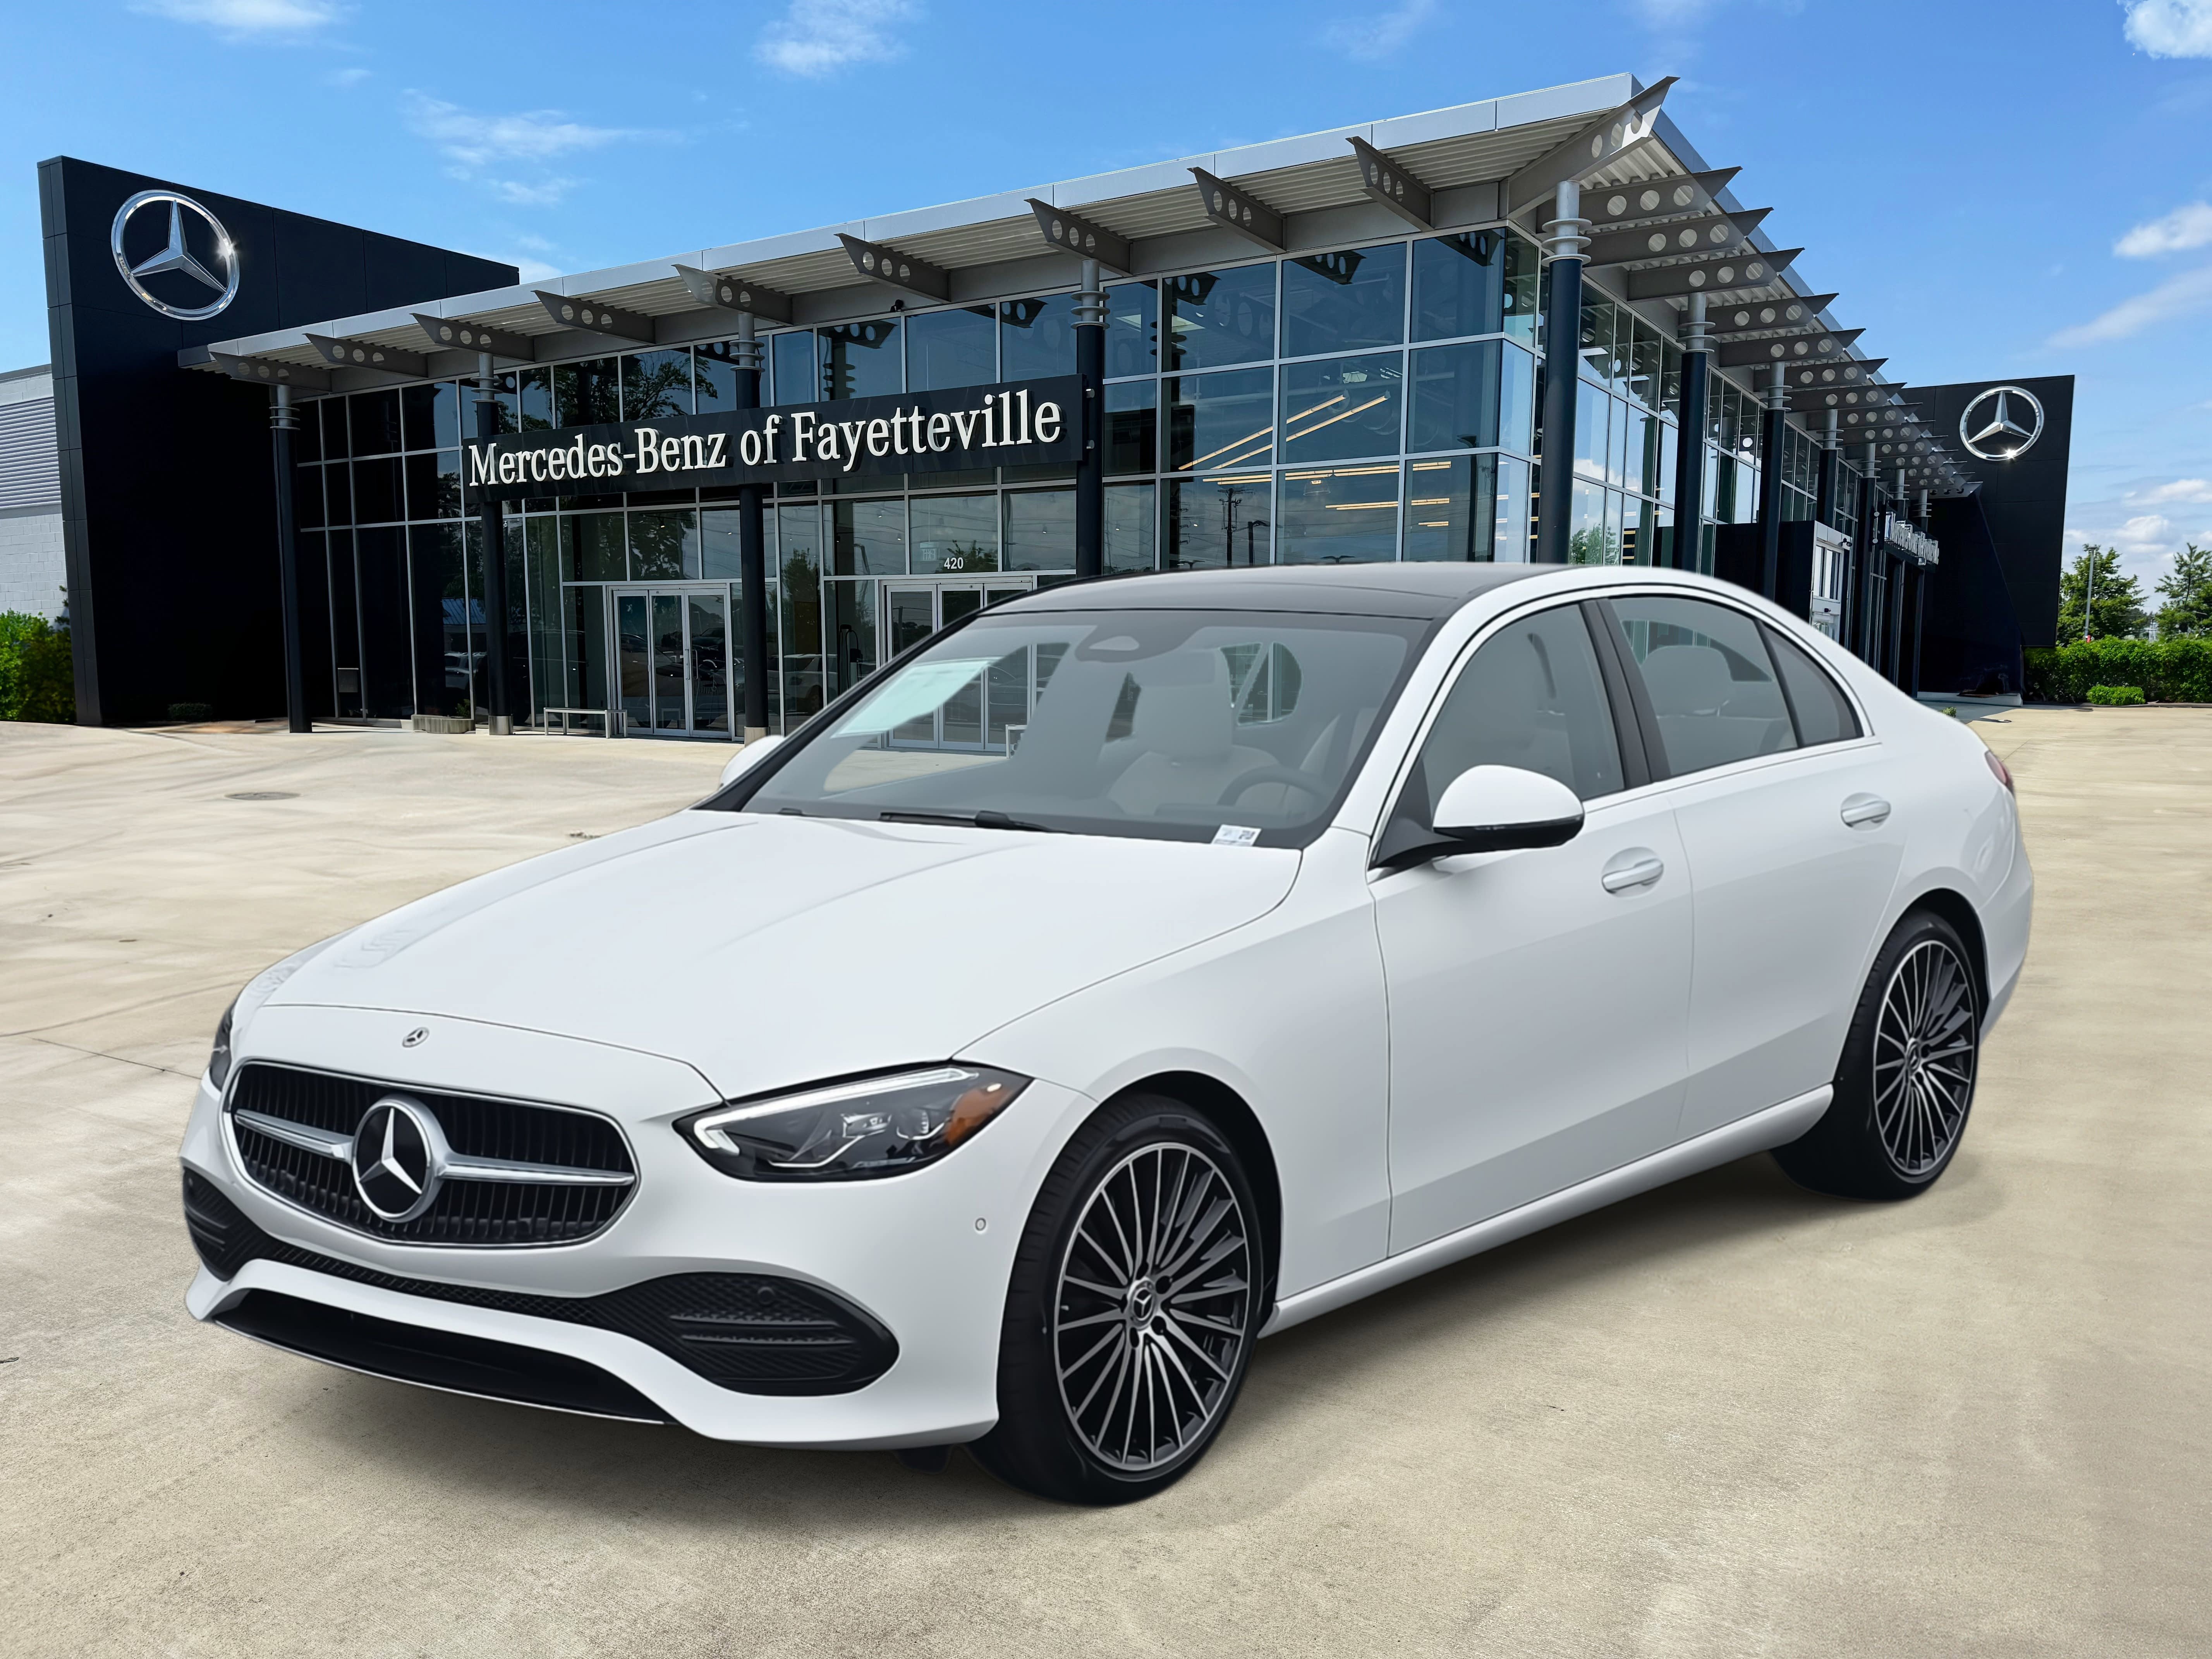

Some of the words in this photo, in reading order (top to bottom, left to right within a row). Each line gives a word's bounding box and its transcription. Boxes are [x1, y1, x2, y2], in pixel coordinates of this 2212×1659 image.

[468, 427, 726, 487] Mercedes-Benz
[740, 414, 781, 466] of
[790, 388, 1062, 472] Fayetteville
[944, 557, 964, 569] 420
